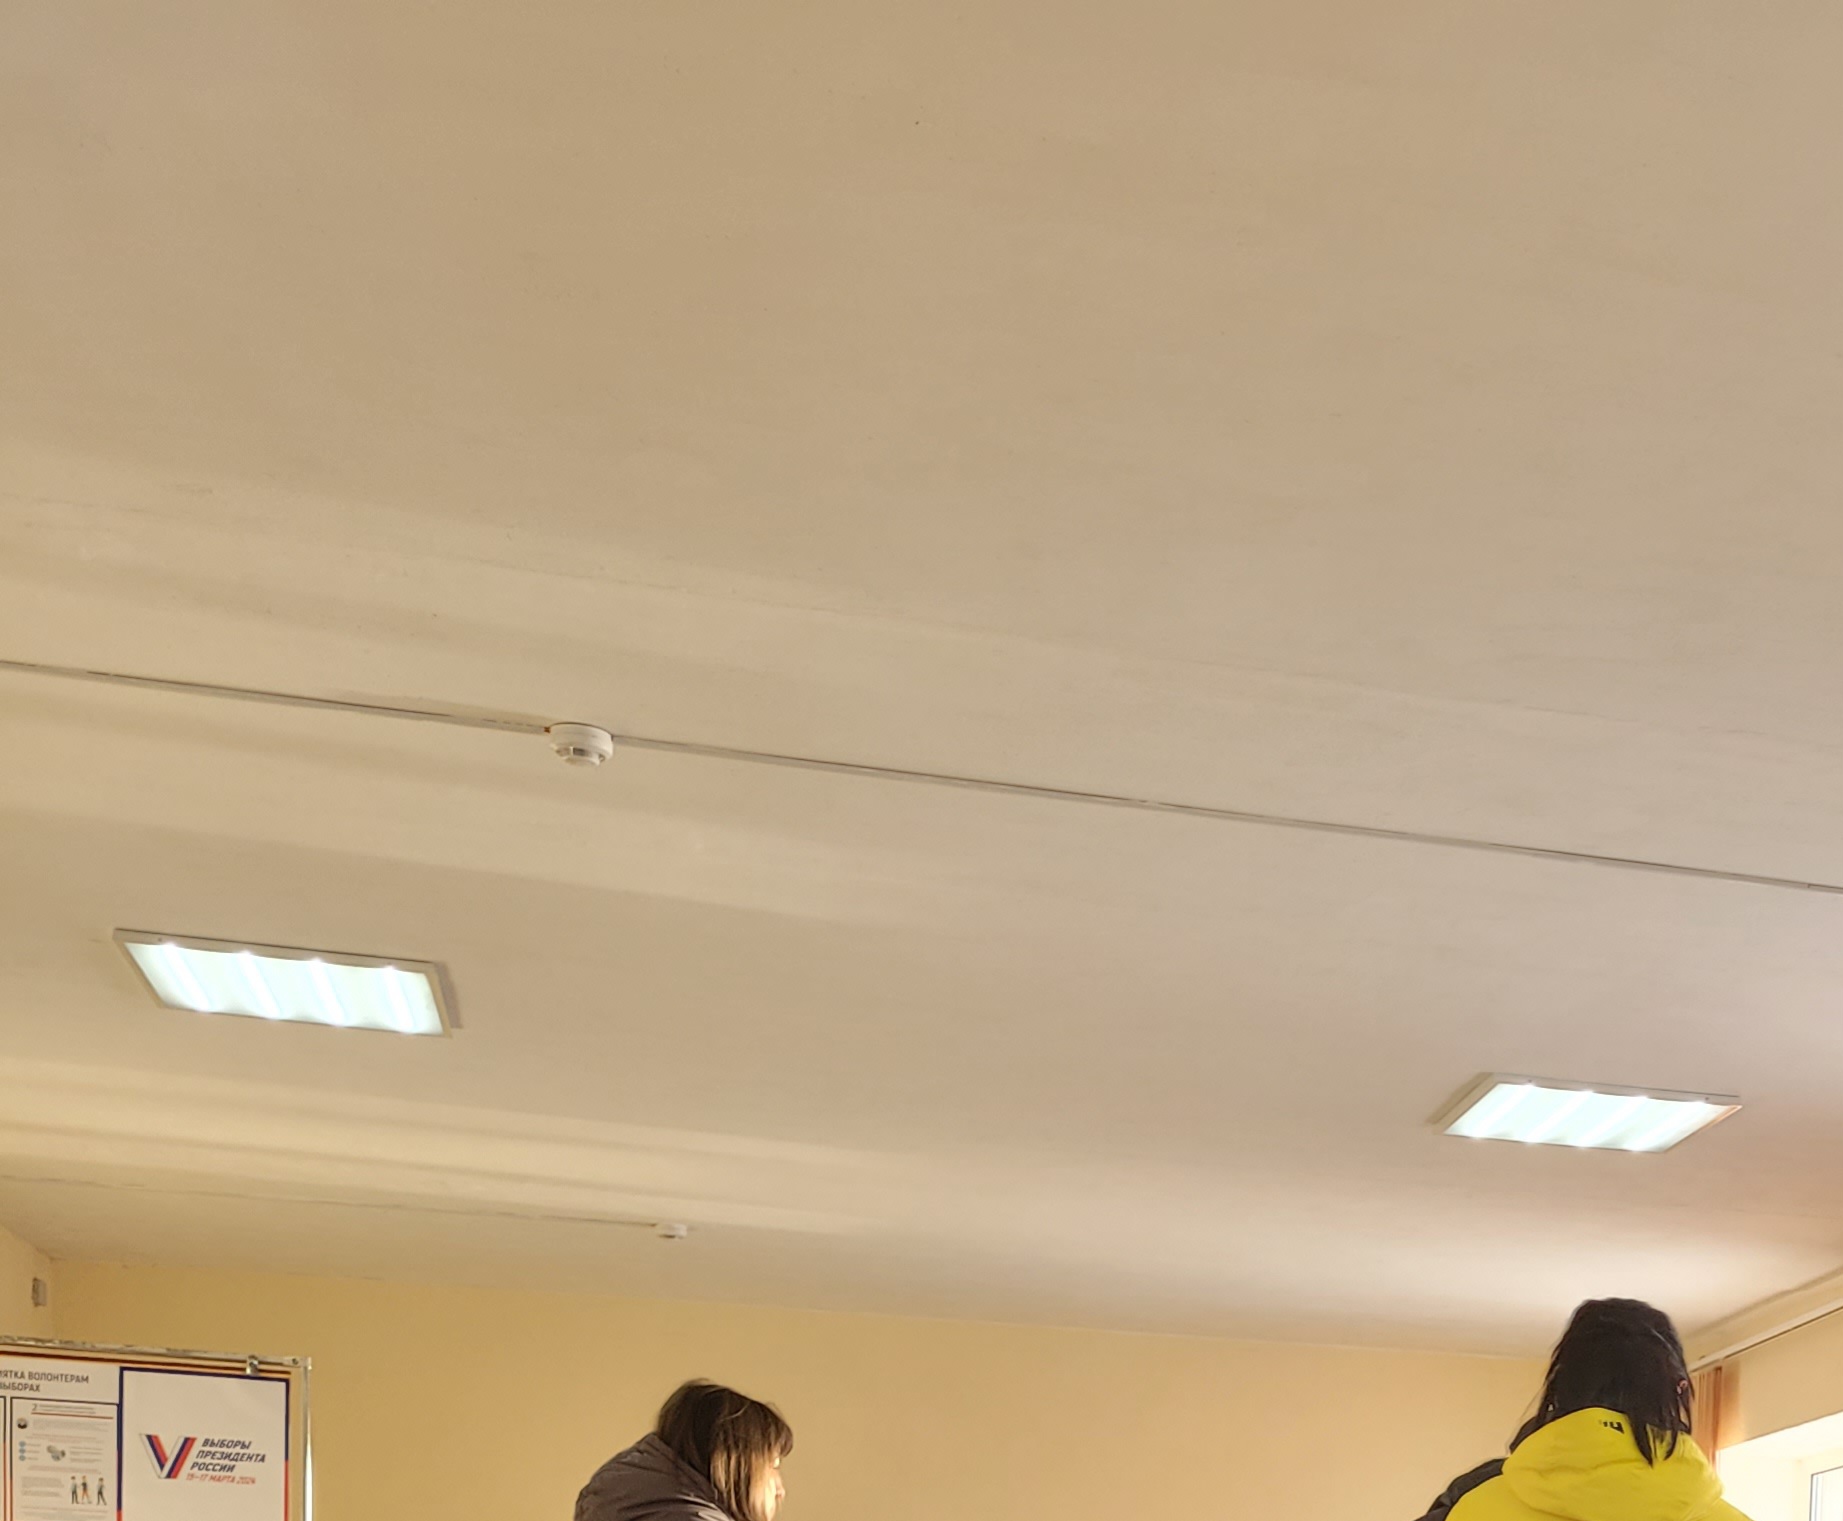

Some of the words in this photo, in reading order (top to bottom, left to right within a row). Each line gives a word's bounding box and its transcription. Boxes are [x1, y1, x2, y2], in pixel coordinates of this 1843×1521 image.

[0, 1370, 26, 1380] ЯТКА
[28, 1371, 89, 1384] ВОЛОНТЕРАМ
[202, 1438, 252, 1450] ВЫБОРЫ
[196, 1450, 266, 1463] ПРЕЗИДЕНТА
[190, 1462, 236, 1473] РОССИИ
[209, 1474, 235, 1483] МАРТА
